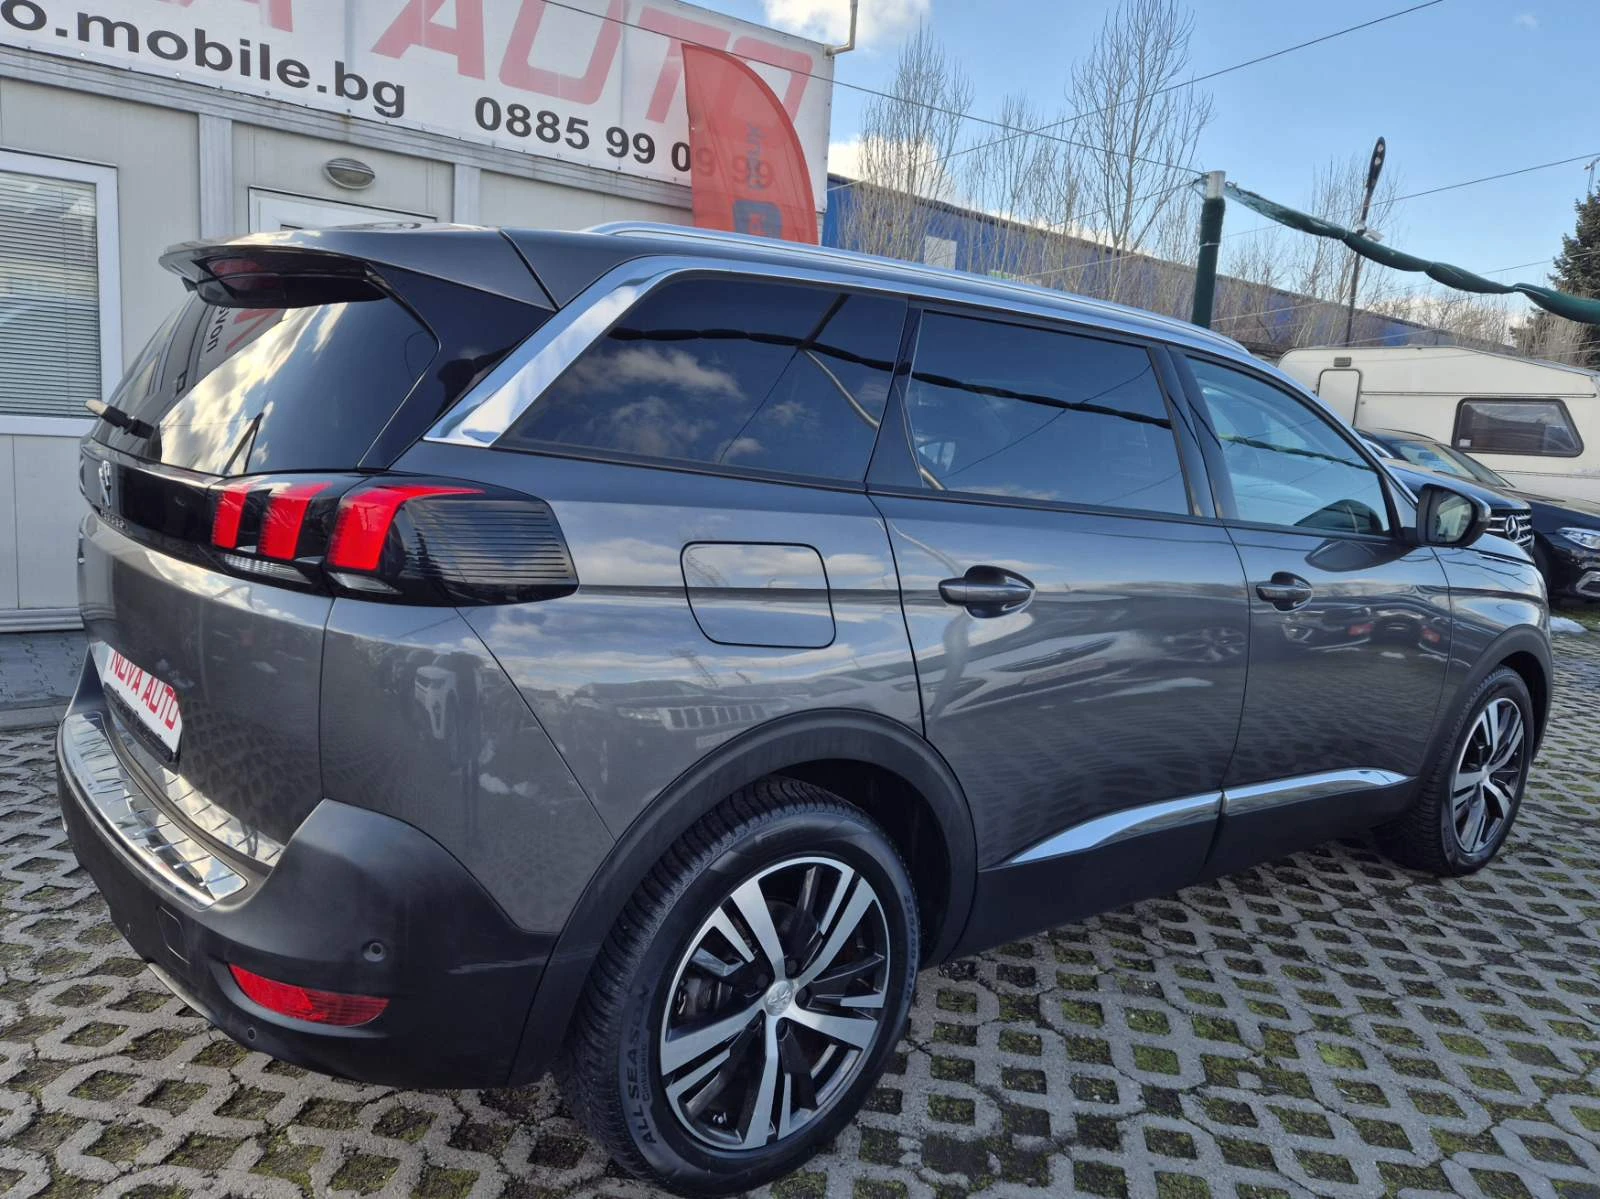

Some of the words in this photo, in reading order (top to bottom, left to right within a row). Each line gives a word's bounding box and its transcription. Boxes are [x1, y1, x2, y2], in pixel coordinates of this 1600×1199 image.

[474, 96, 590, 150] 0885
[605, 126, 656, 164] 99
[110, 651, 145, 696] NOVA
[141, 676, 181, 730] AUTO
[634, 1104, 657, 1145] ALL
